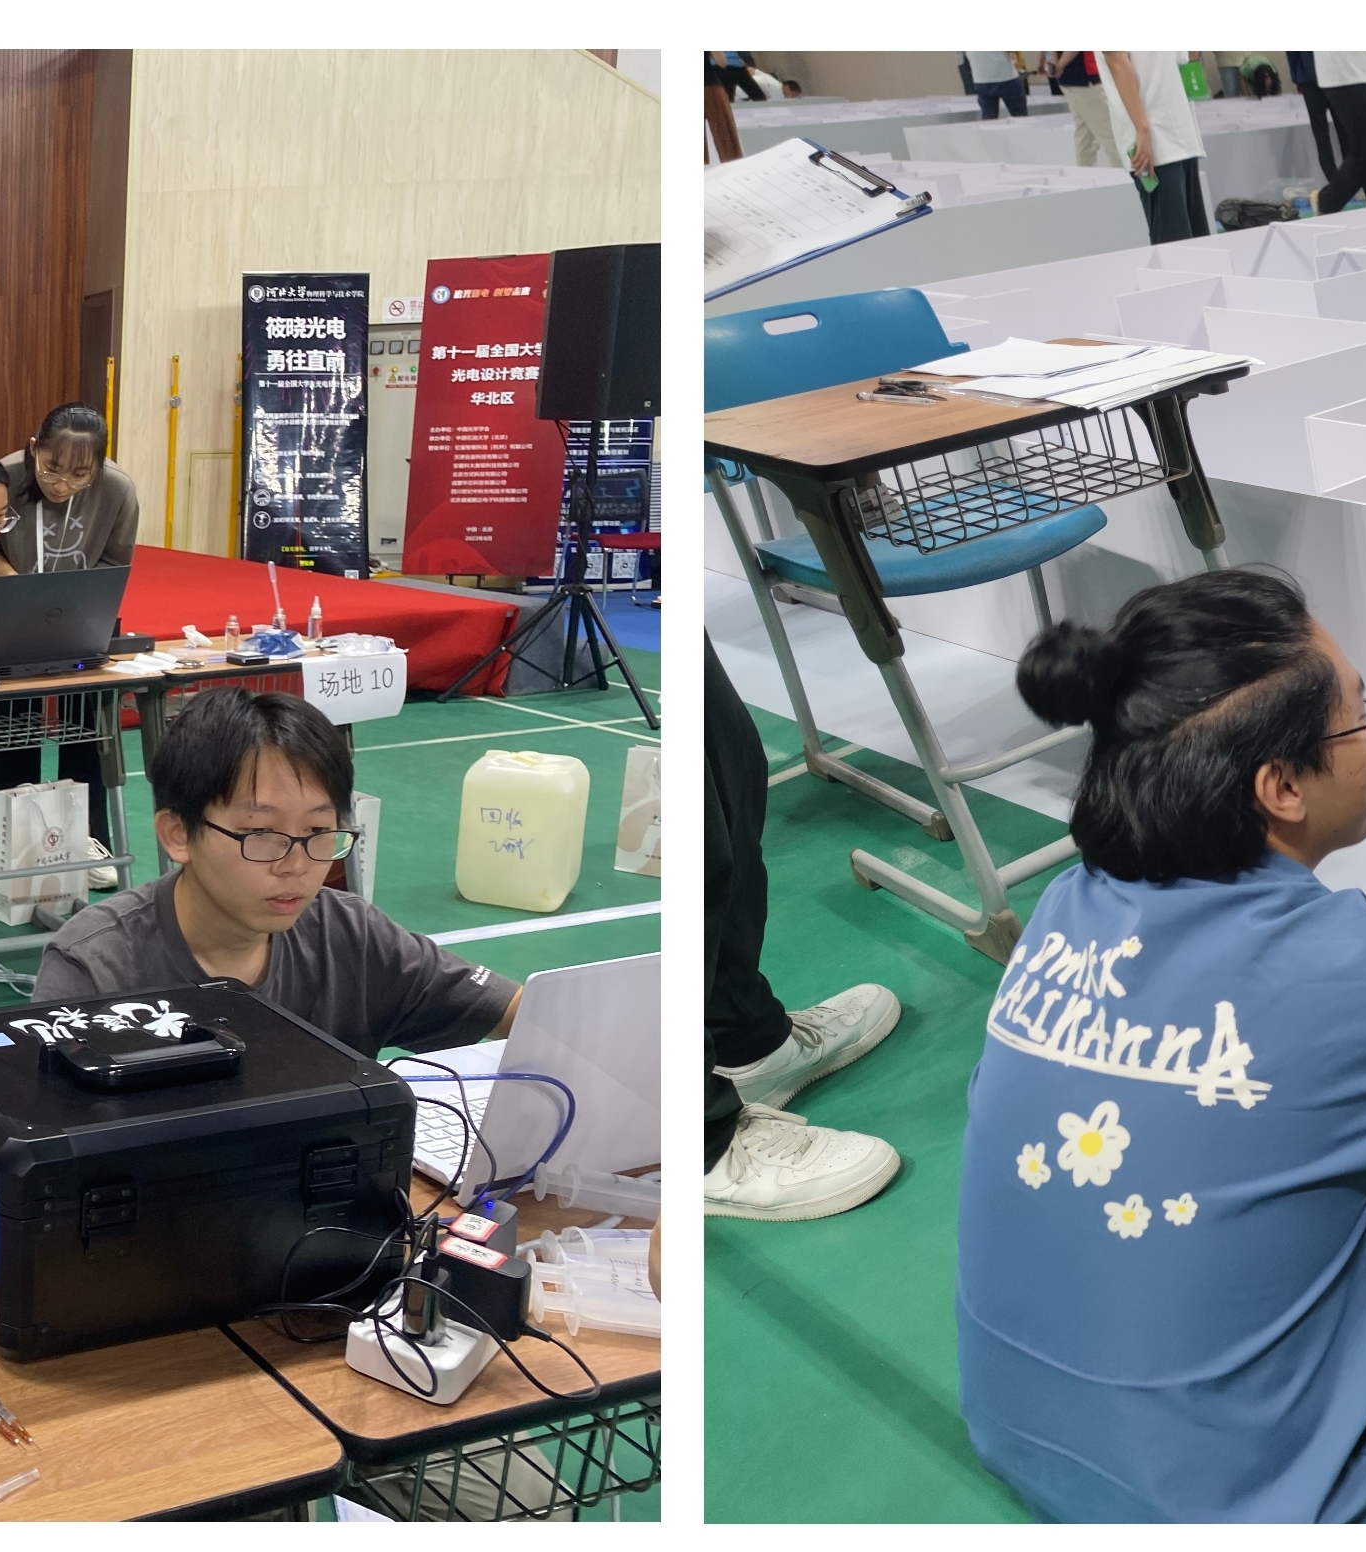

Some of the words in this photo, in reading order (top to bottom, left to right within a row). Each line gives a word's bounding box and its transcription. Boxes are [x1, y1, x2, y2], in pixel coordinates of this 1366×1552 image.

[265, 316, 347, 340] 筱晓光电
[266, 348, 347, 373] 勇往直前
[451, 365, 540, 383] 光电设计竞赛
[470, 391, 515, 406] 华北区
[318, 667, 364, 698] 场地
[370, 667, 394, 690] 10
